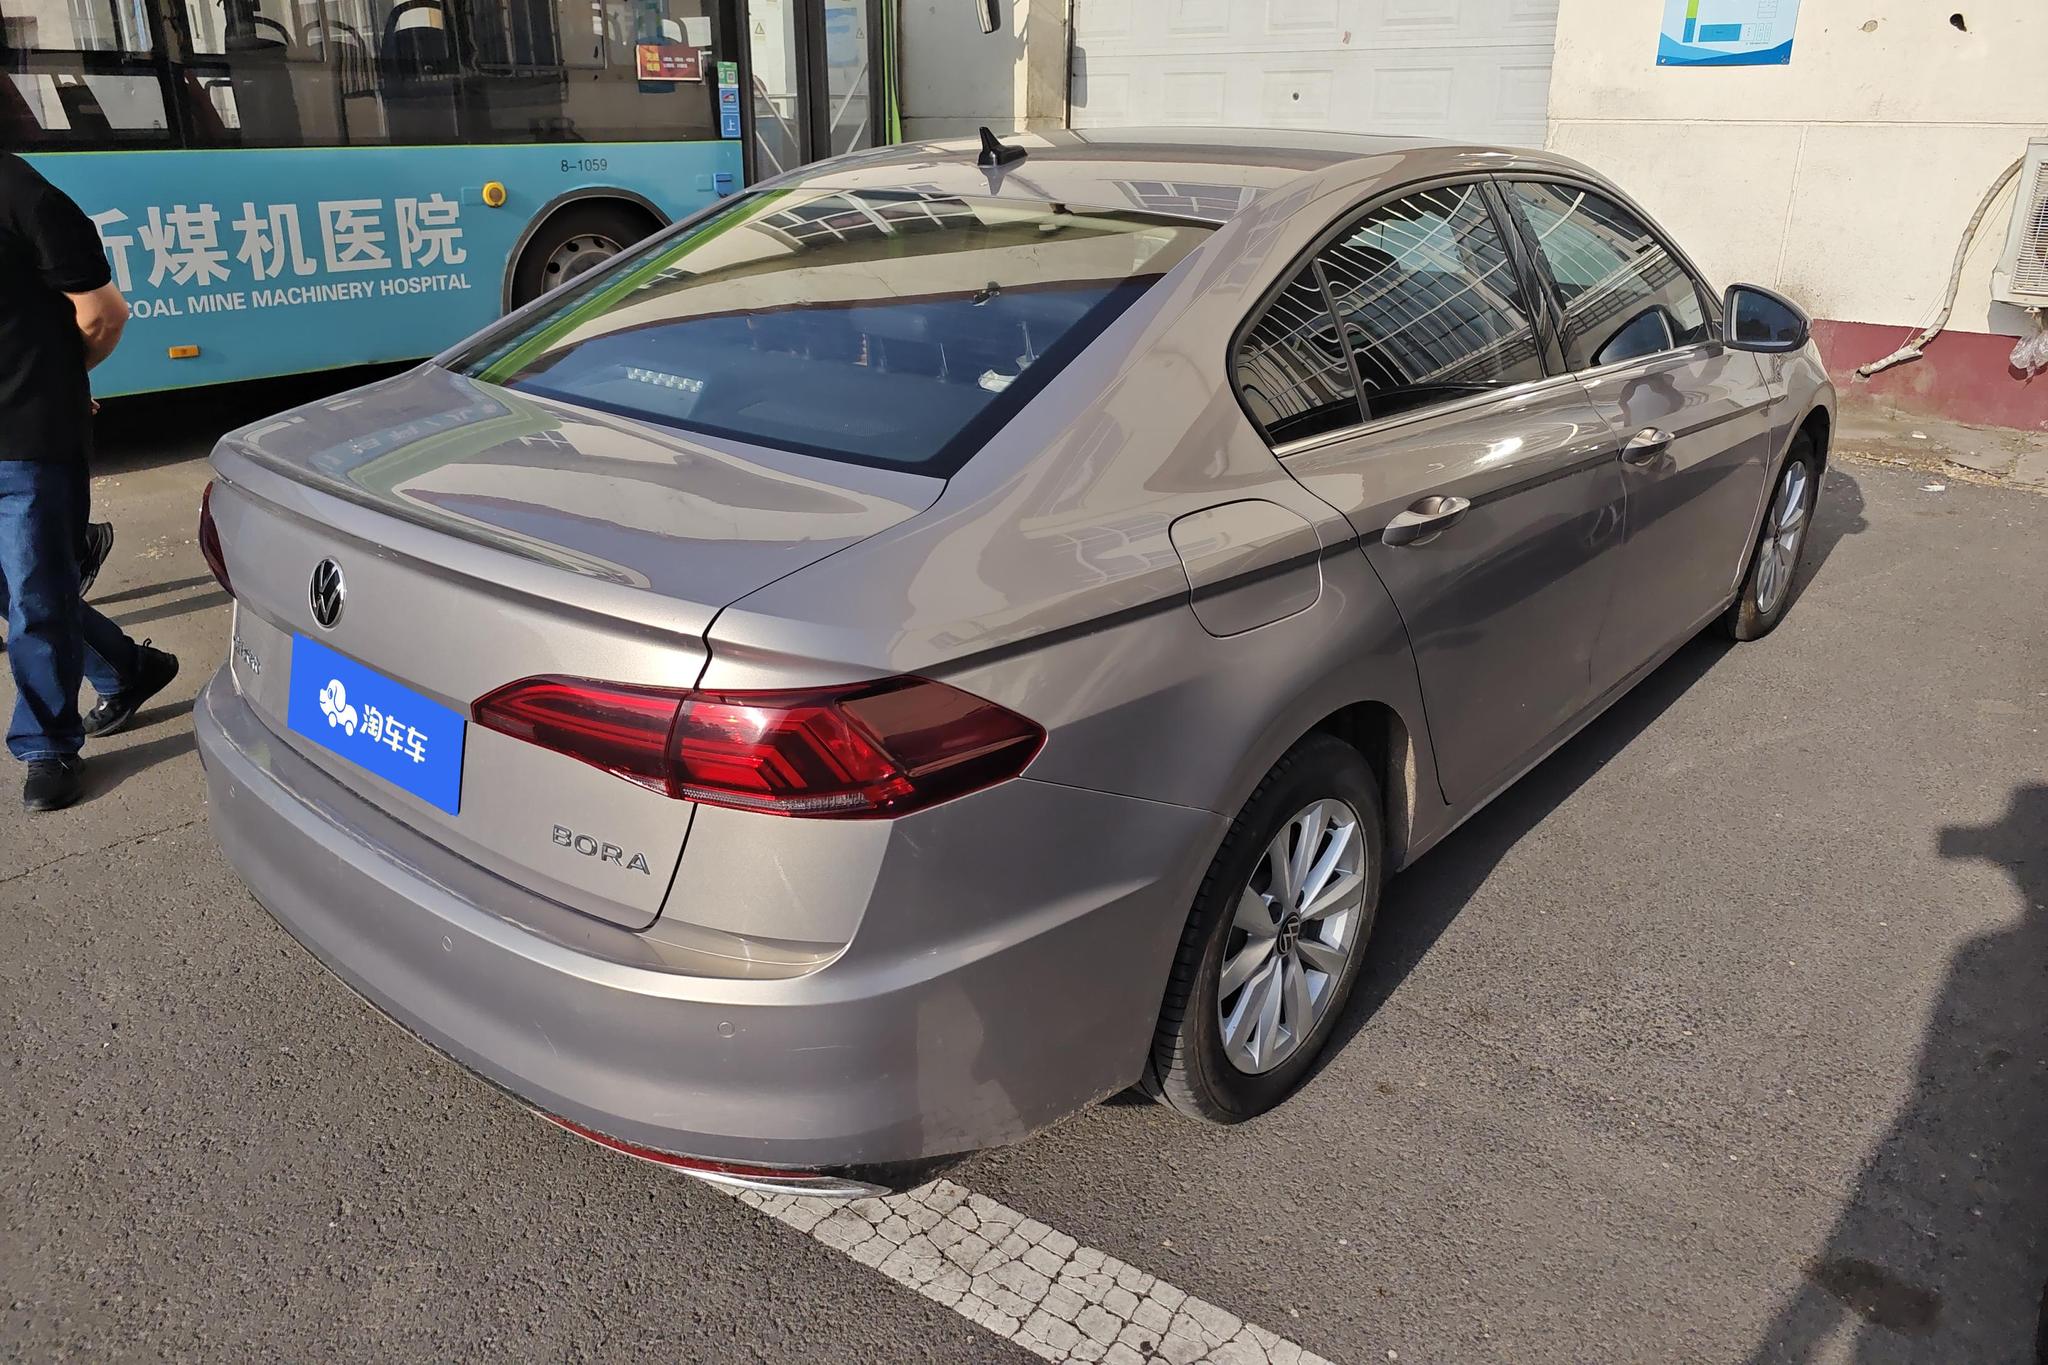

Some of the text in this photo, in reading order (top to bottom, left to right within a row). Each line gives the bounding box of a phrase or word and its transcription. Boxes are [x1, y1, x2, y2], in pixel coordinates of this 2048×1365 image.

[727, 119, 737, 131] 上
[561, 158, 608, 173] 8-1059
[188, 292, 247, 314] MINE
[252, 281, 375, 307] MACHINERY
[381, 273, 472, 296] HOSPITAL
[552, 824, 651, 876] BORA
